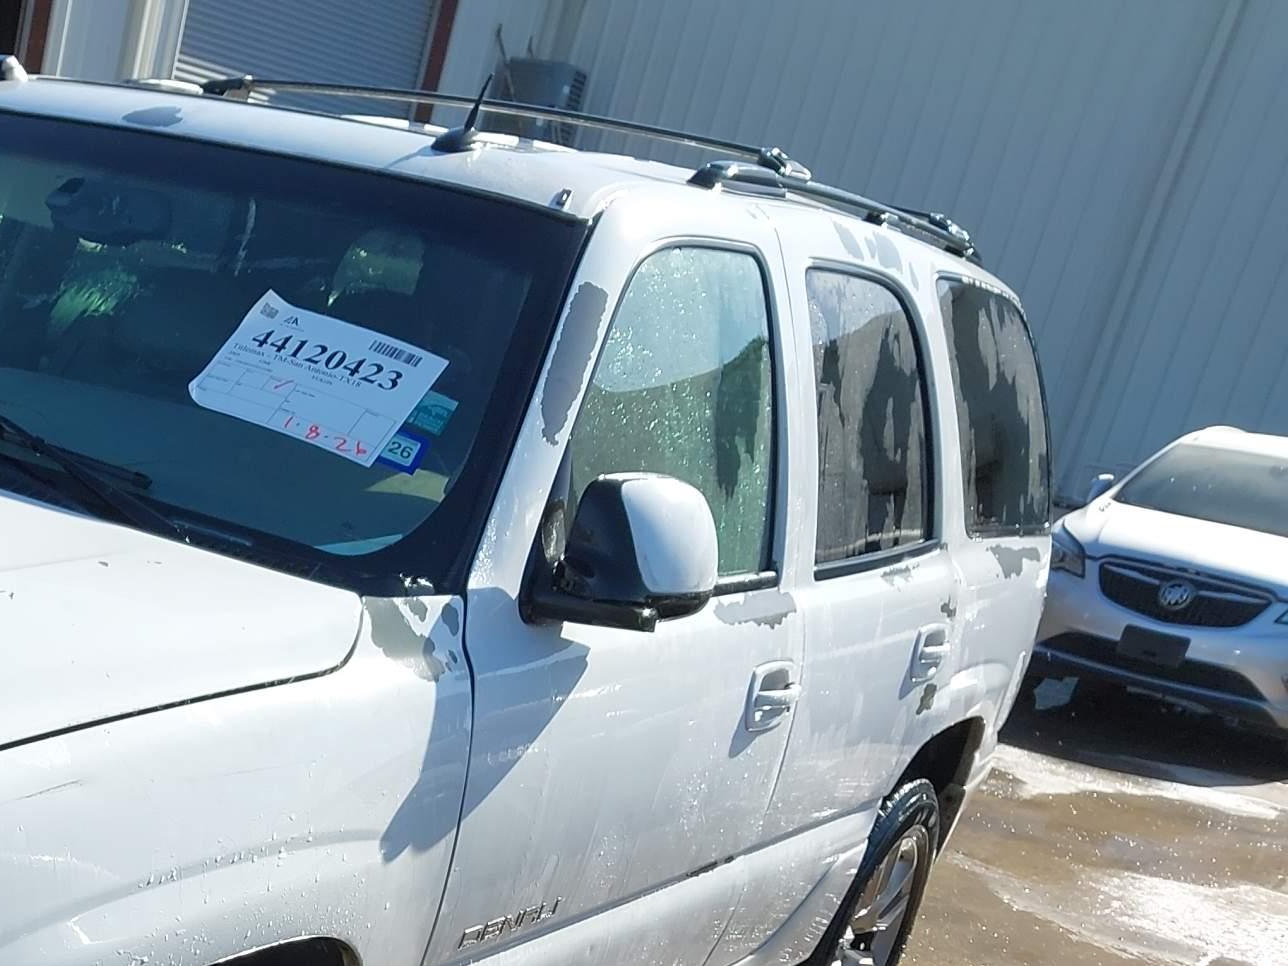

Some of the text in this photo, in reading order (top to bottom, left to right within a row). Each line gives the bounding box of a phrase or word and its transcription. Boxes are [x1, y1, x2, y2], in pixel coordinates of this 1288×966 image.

[252, 330, 403, 390] 44120423
[388, 441, 413, 459] 26
[457, 896, 563, 950] DENALI
